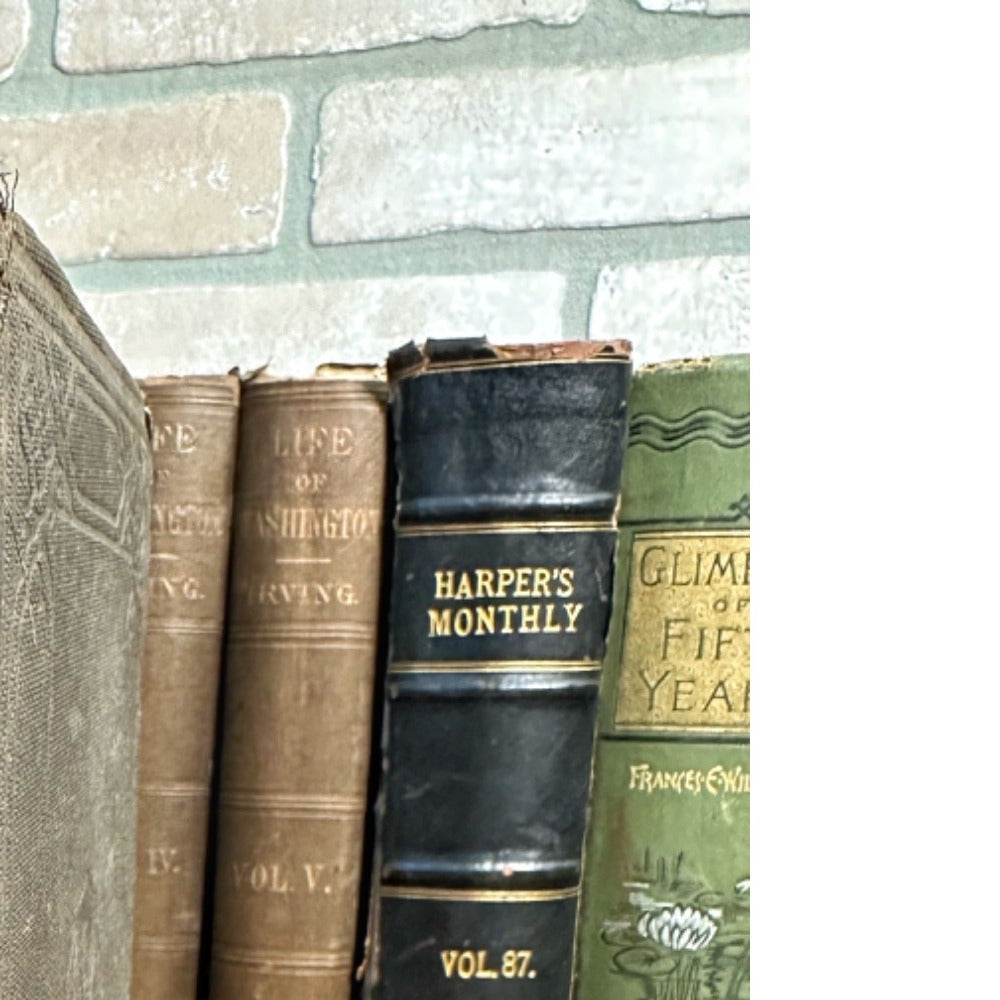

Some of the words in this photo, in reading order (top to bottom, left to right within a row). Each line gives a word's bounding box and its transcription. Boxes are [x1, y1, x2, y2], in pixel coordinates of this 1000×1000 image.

[274, 426, 354, 457] LIFE
[295, 472, 328, 493] OF
[433, 567, 575, 600] HARPER'S
[427, 602, 584, 638] MONTHLY
[501, 950, 538, 979] 87.
